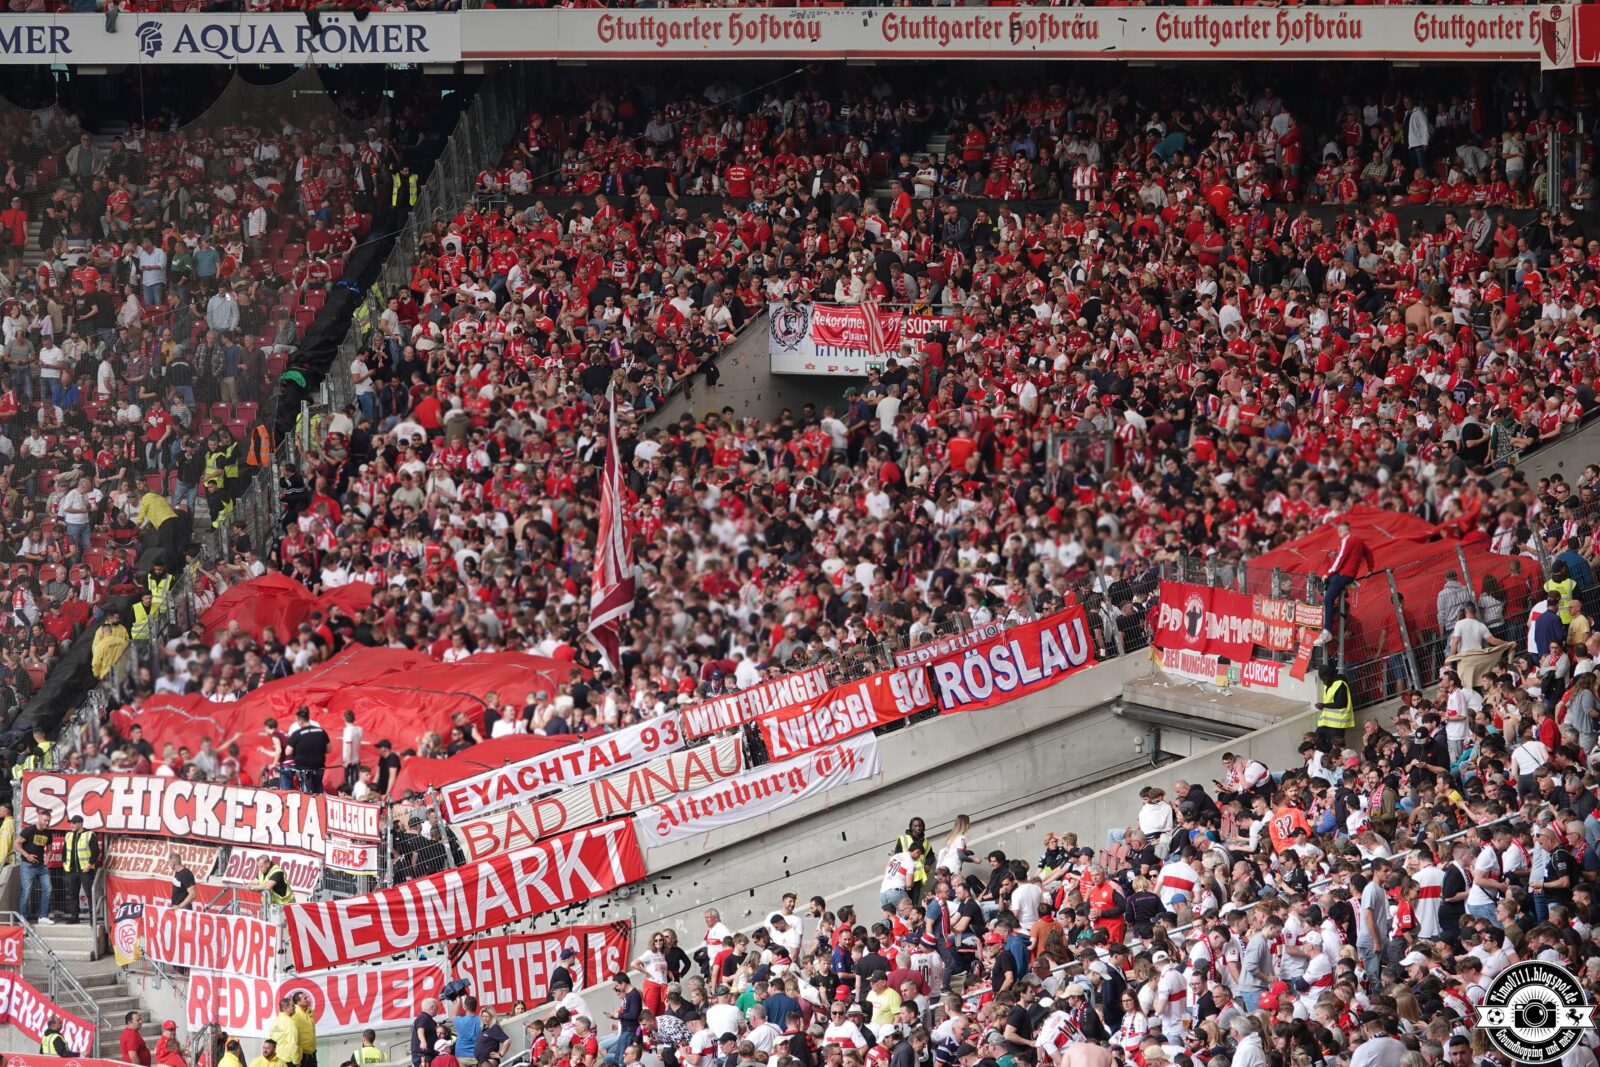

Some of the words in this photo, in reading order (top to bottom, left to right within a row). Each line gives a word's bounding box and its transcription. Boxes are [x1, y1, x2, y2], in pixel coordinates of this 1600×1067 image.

[172, 24, 285, 60] AQUA
[294, 17, 430, 53] RÖMER
[597, 13, 724, 48] Stuttgarter
[882, 12, 1004, 48] Stuttgarter
[1008, 11, 1099, 46] Hofbräu
[1155, 11, 1271, 48] Stuttgarter
[1275, 10, 1362, 46] Hofbräu
[1413, 11, 1524, 48] Stuttgarter
[934, 617, 1088, 710] RÖSLAU
[1164, 649, 1180, 669] RED
[685, 665, 828, 736] WINTERLINGEN
[764, 682, 877, 759] Zwiesel
[447, 739, 632, 815] EYACHTAL
[641, 718, 680, 754] 93
[24, 775, 326, 855] SCHICKERIA
[328, 800, 378, 836] COLEGIO
[461, 798, 568, 861] BAD
[589, 743, 743, 818] IMNAU
[656, 766, 808, 837] Altenburg
[1275, 815, 1294, 839] 32
[104, 856, 152, 873] IMMER
[888, 859, 901, 877] 50
[291, 821, 627, 967] NEUMARKT
[145, 906, 276, 979] ROHRDORF
[457, 934, 584, 1006] SELTERS
[188, 974, 250, 1030] RED
[254, 965, 446, 1031] POWER
[1057, 1018, 1079, 1041] 14
